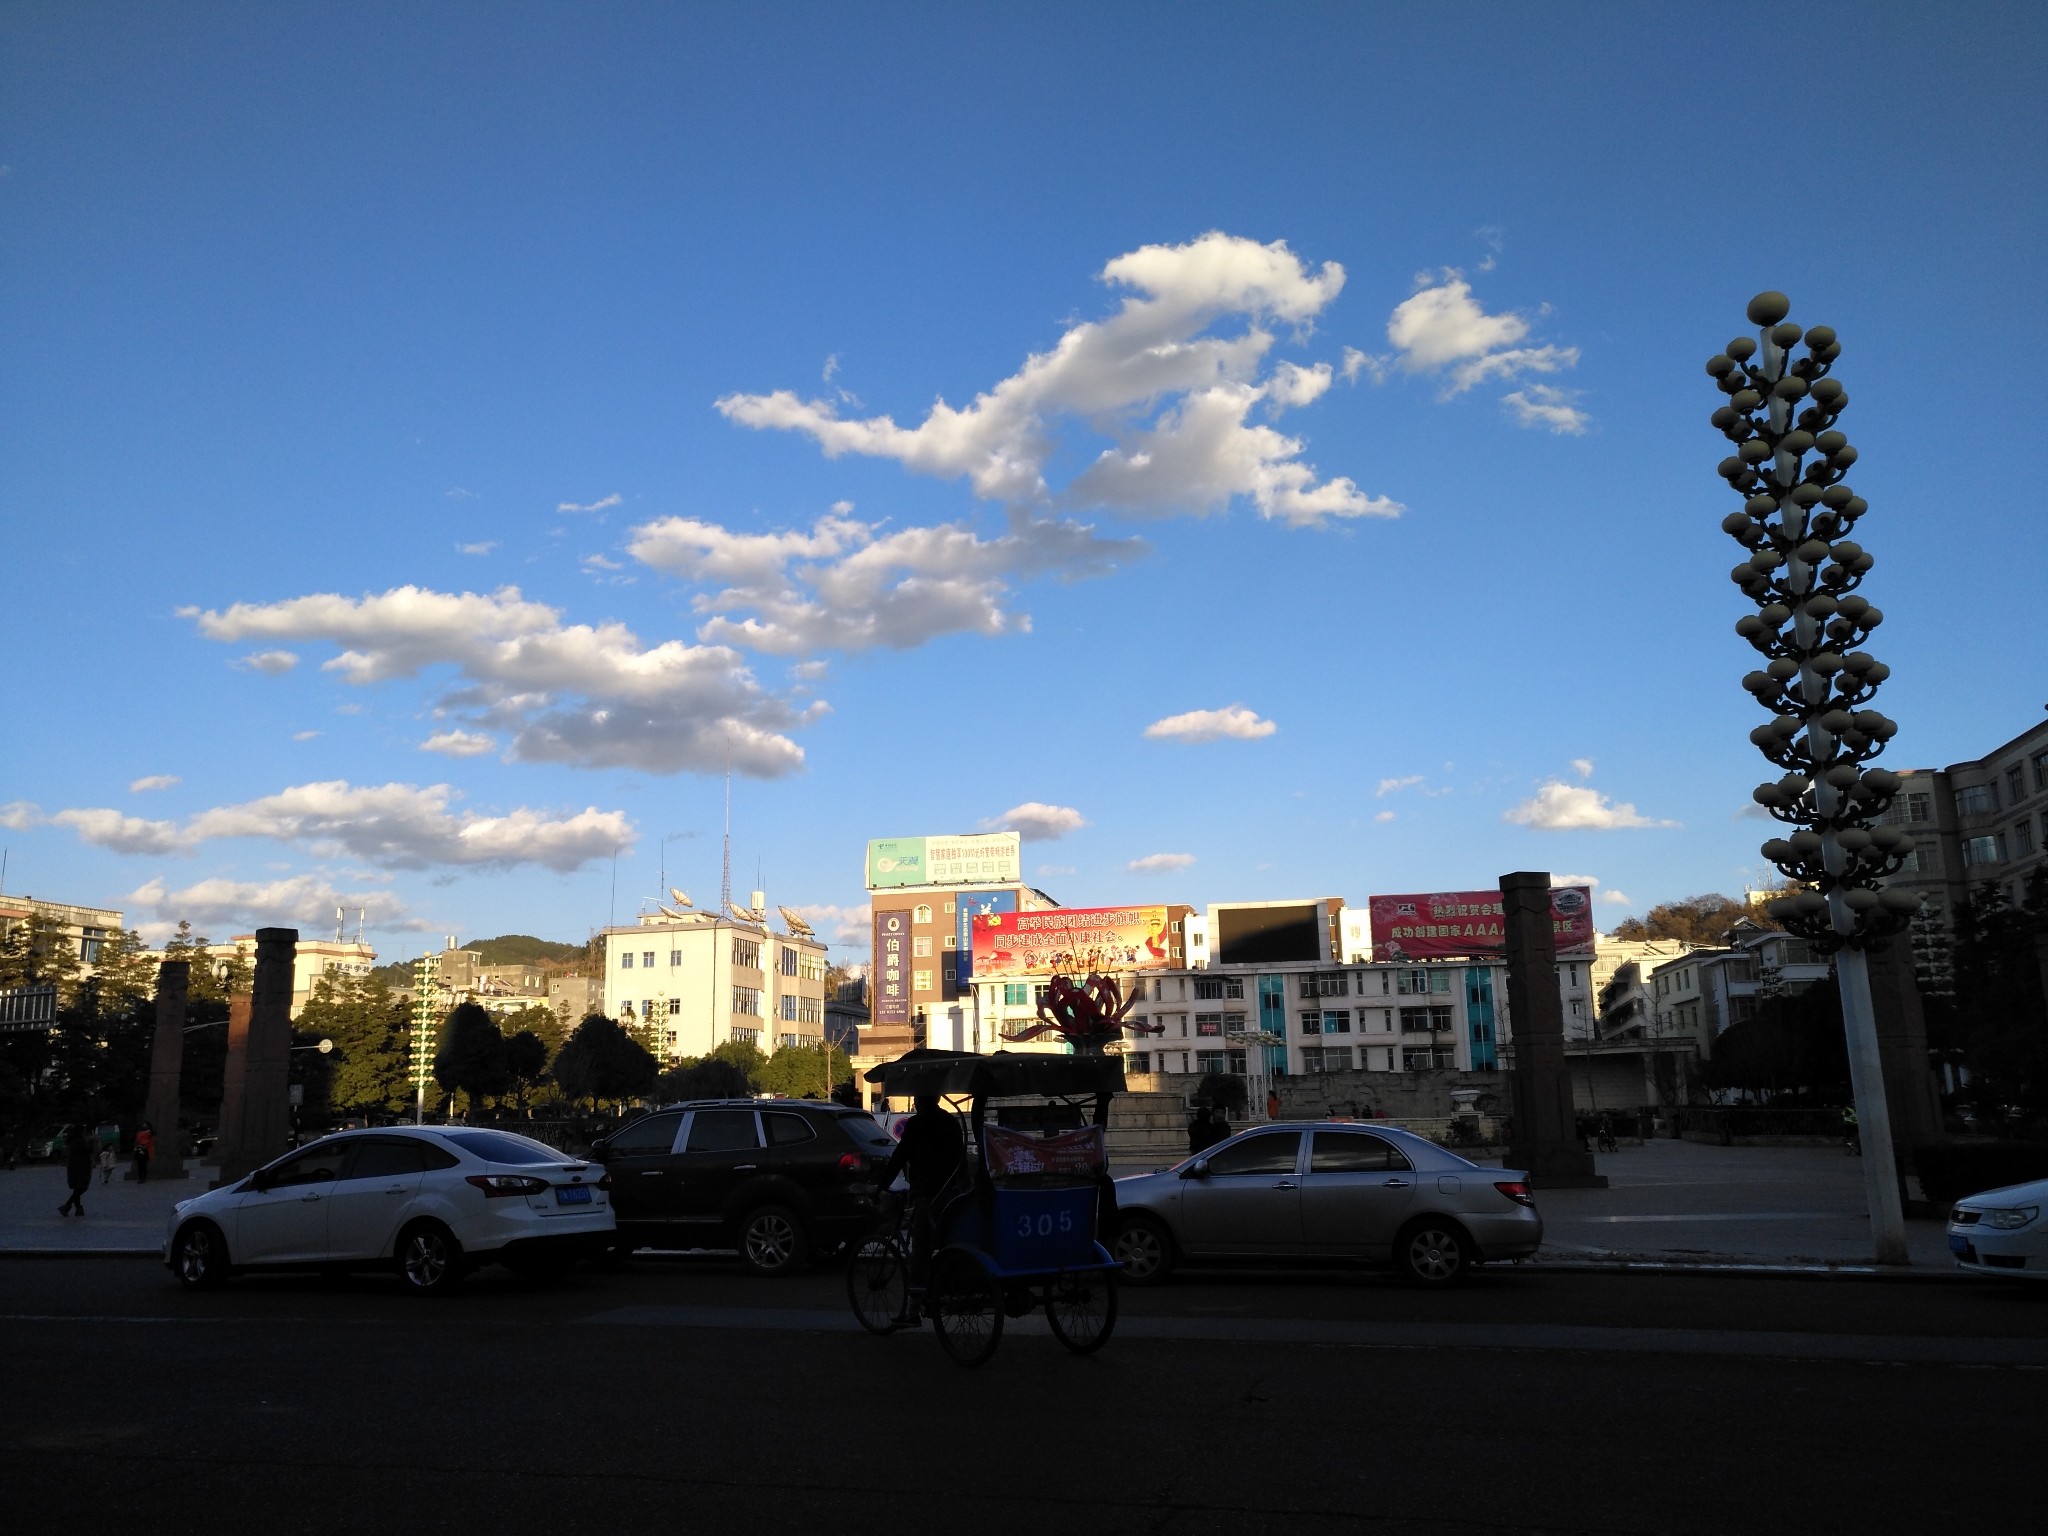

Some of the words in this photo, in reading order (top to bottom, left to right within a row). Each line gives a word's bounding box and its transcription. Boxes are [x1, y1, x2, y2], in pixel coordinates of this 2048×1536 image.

[1433, 903, 1503, 918] 热烈祝贺会理
[1391, 923, 1505, 939] 成功创建国家AAA
[886, 938, 900, 997] 伯爵咖啡
[1017, 1209, 1072, 1237] 305
